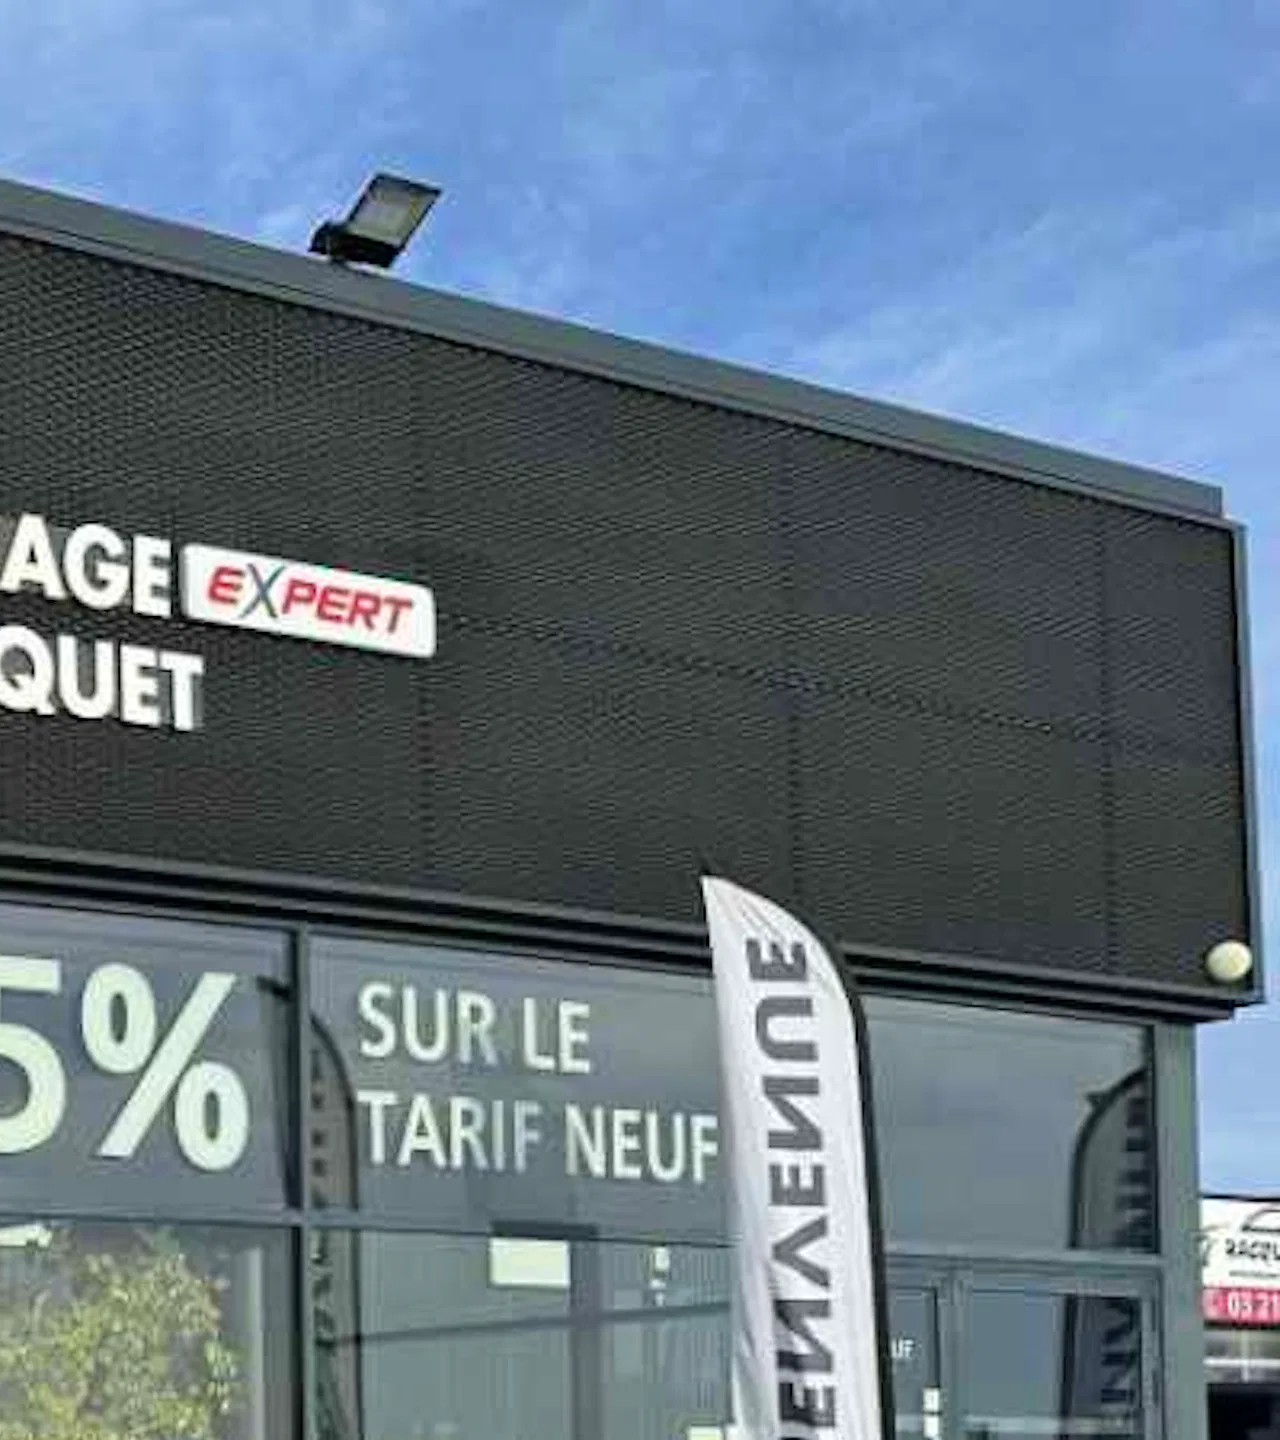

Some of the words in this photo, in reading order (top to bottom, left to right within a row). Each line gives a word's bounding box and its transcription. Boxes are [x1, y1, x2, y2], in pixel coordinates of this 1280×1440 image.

[207, 562, 413, 635] EXPERT
[359, 983, 497, 1065] SUR
[523, 996, 592, 1074] LE
[359, 1090, 542, 1174] TARIF
[565, 1105, 719, 1184] NEUF
